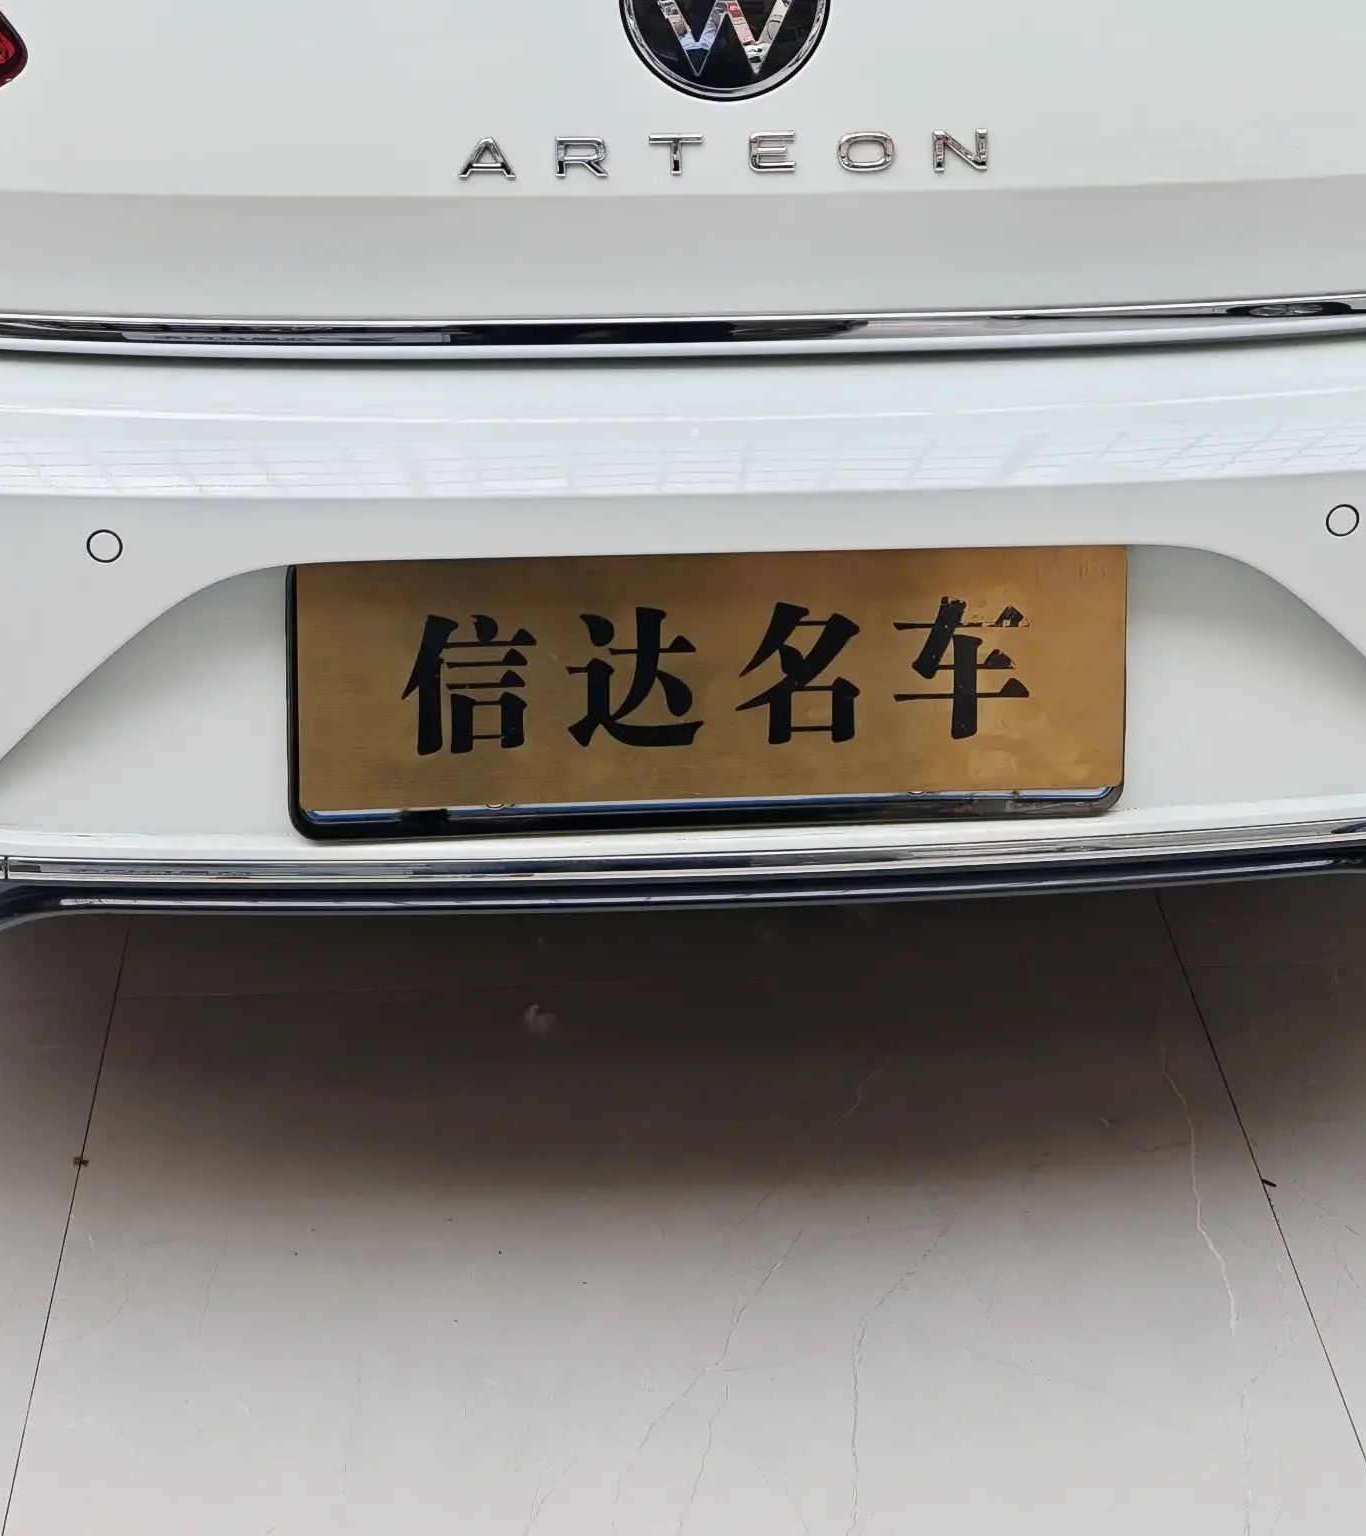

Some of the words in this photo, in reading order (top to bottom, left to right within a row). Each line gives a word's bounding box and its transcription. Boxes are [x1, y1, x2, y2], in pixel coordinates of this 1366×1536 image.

[457, 127, 989, 181] ARTEON
[401, 595, 1031, 756] 信达名车
